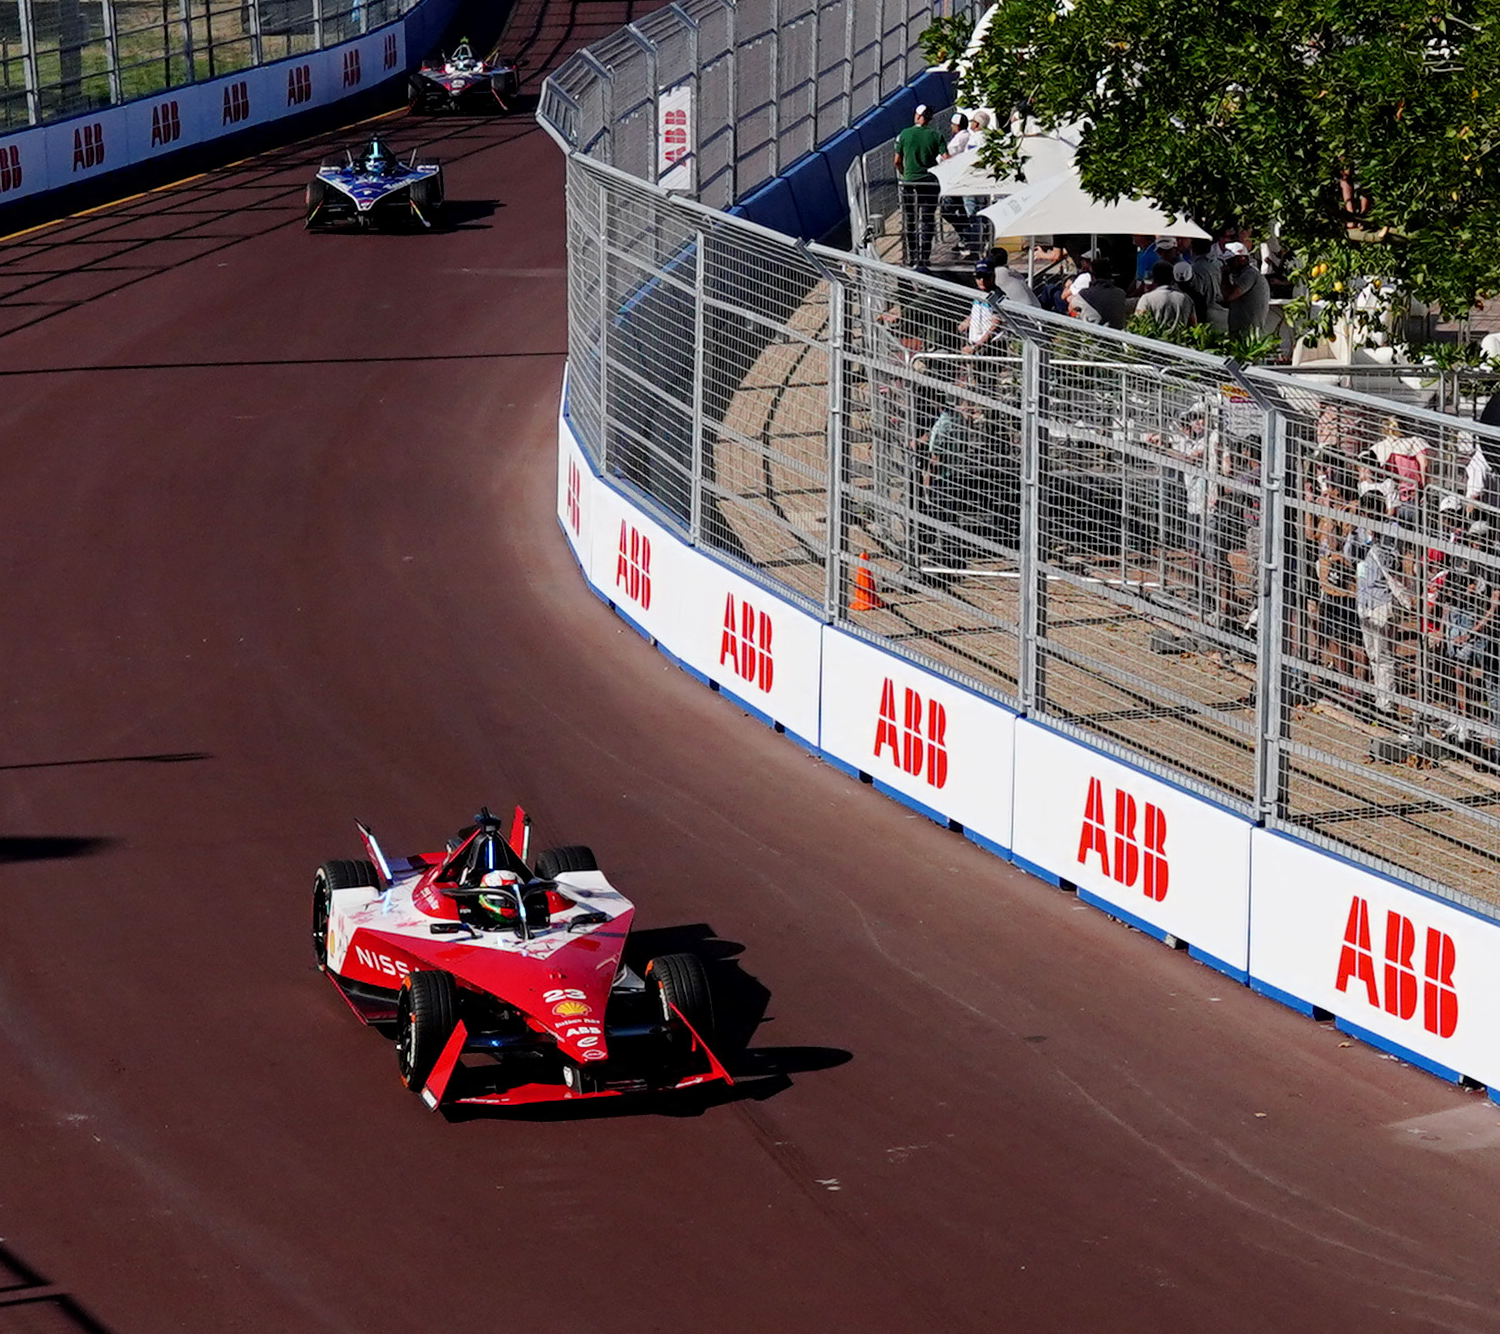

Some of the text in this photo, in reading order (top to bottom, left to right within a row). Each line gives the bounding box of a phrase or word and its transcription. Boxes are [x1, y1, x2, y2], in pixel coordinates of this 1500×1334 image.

[287, 65, 312, 107] ABB
[343, 49, 361, 88] ABB
[151, 100, 181, 148] ABB
[222, 82, 249, 127] ABB
[73, 122, 105, 173] ABB
[566, 453, 582, 538] ABB
[615, 517, 652, 612] ABB
[719, 590, 775, 696] ABB
[872, 676, 950, 791] ABB
[1075, 774, 1171, 904] ABB
[355, 945, 420, 978] NISS
[1333, 894, 1460, 1040] ABB
[543, 989, 587, 1003] 23
